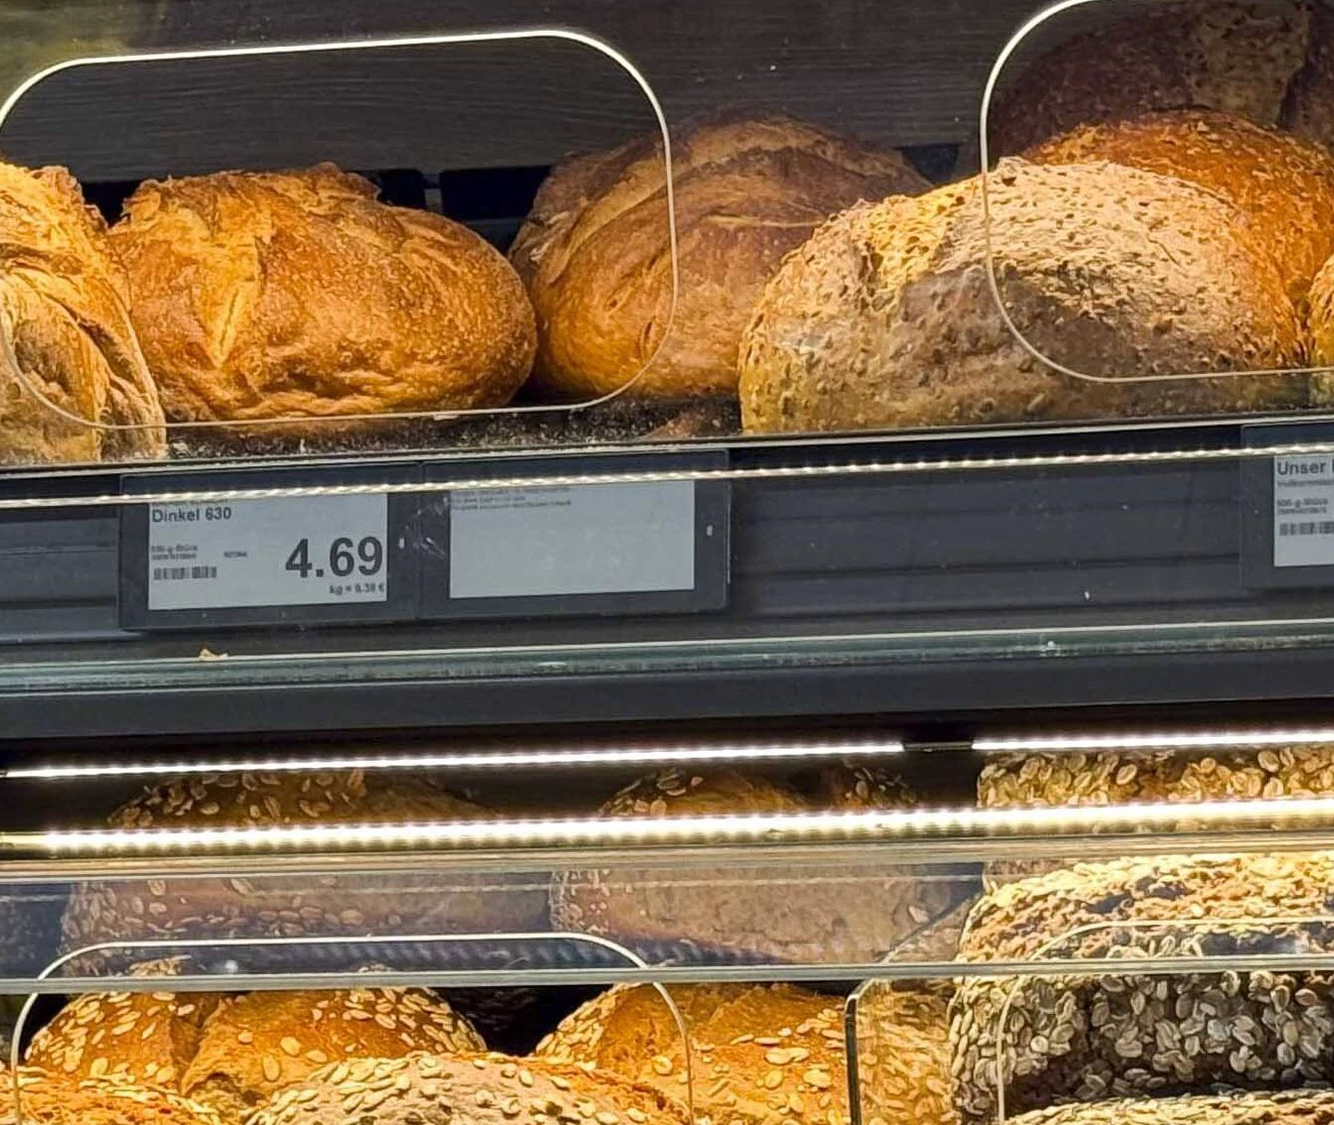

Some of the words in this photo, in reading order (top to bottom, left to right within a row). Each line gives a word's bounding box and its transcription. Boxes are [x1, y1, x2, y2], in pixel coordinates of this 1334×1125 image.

[1277, 461, 1327, 475] Unser
[151, 506, 200, 522] Dinkel
[205, 507, 232, 520] 630
[285, 536, 384, 578] 4.69
[329, 585, 344, 596] kg
